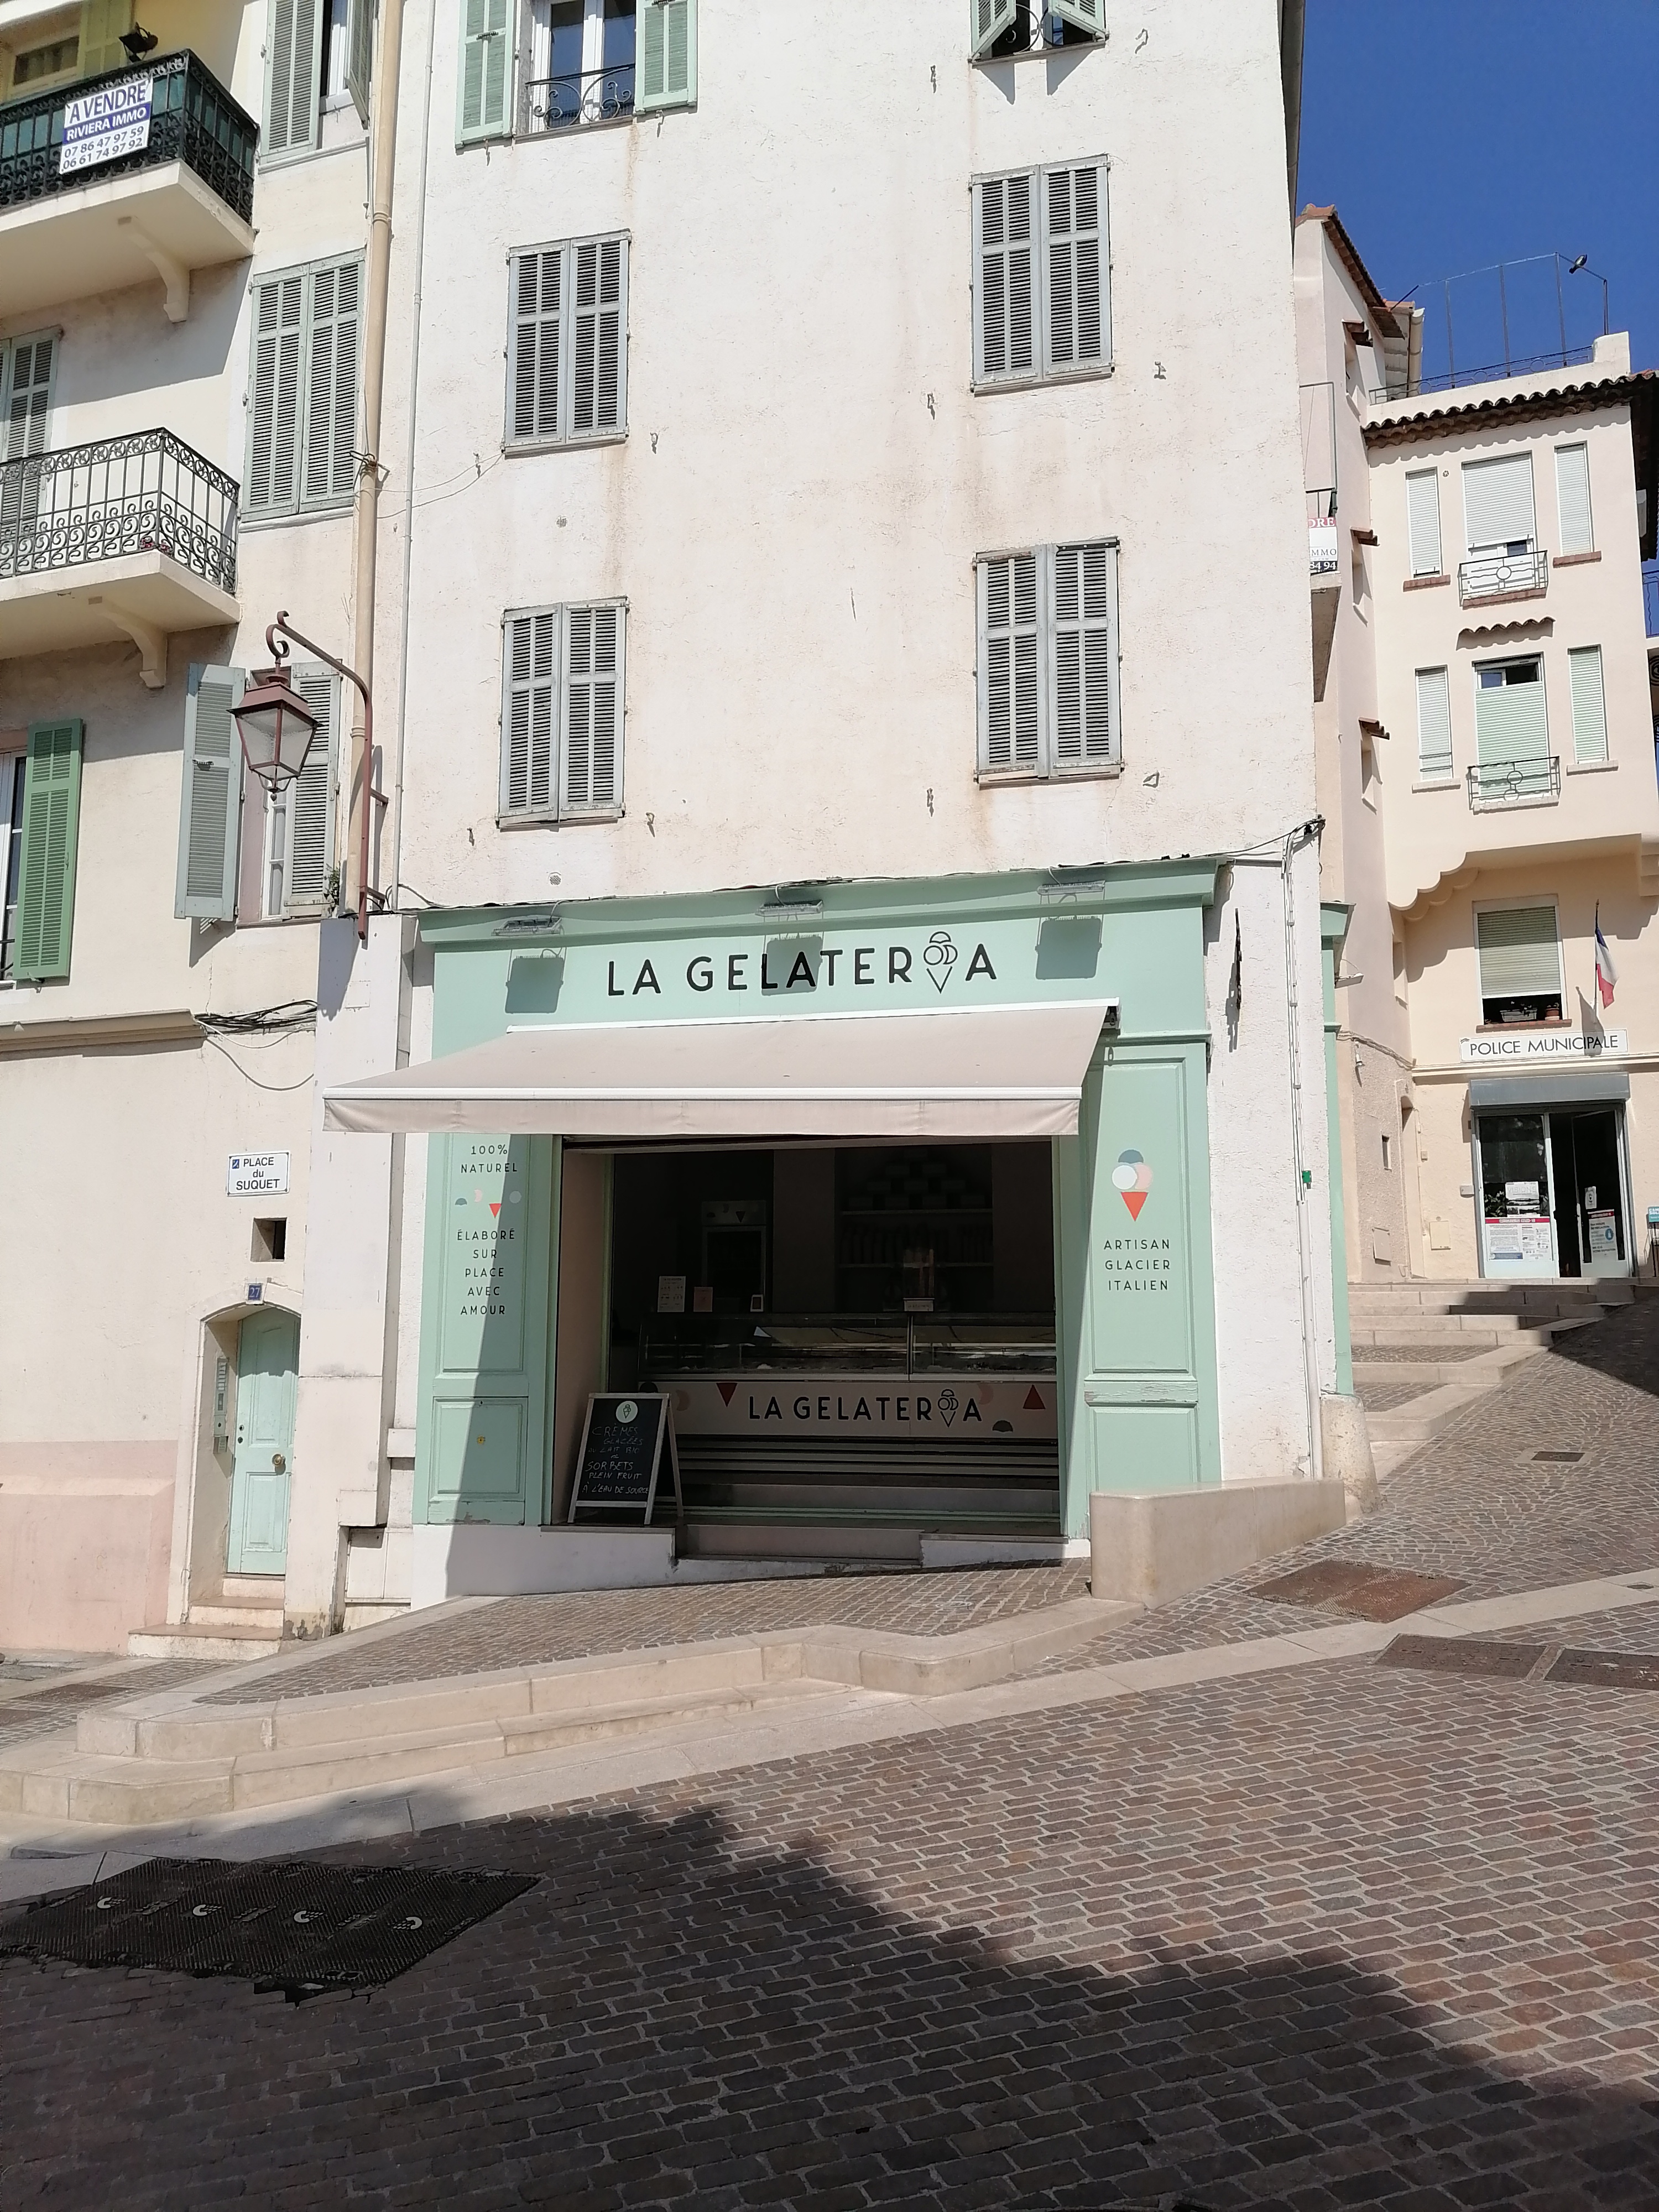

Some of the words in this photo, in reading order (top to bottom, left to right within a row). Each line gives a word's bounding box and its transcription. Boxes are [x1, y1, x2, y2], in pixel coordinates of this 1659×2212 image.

[70, 103, 80, 124] A
[84, 82, 146, 118] VENDRE
[67, 119, 110, 140] RIVIERA
[112, 107, 146, 127] IMMO
[65, 146, 78, 158] 07
[81, 141, 95, 153] 86
[97, 136, 111, 148] 47
[113, 131, 127, 143] 97
[129, 126, 144, 138] 59
[63, 157, 76, 169] 06
[79, 153, 92, 165] 61
[96, 148, 109, 160] 74
[112, 143, 126, 155] 97
[128, 137, 143, 149] 92
[608, 959, 661, 996] LA
[1470, 1041, 1521, 1056] POLICE
[1528, 1035, 1619, 1052] MUNICIPALE
[471, 1144, 508, 1155] 100%
[243, 1157, 274, 1167] PLACE
[461, 1162, 518, 1173] NATUREL
[253, 1169, 264, 1178] du
[236, 1179, 280, 1190] SUQUET
[457, 1228, 515, 1240] ÉLABORÉ
[1104, 1239, 1170, 1250] ARTISAN
[473, 1249, 497, 1259] SUR
[1105, 1260, 1170, 1270] GLACIER
[465, 1267, 504, 1277] PLACE
[1109, 1280, 1168, 1290] ITALIEN
[249, 1287, 260, 1298] 27
[467, 1286, 500, 1296] AVEC
[461, 1305, 505, 1315] AMOUR
[749, 1396, 782, 1420] LA
[585, 1461, 634, 1472] SORBETS
[589, 1472, 612, 1480] PLEIN
[592, 1483, 612, 1493] L'EAU
[614, 1485, 625, 1494] DE
